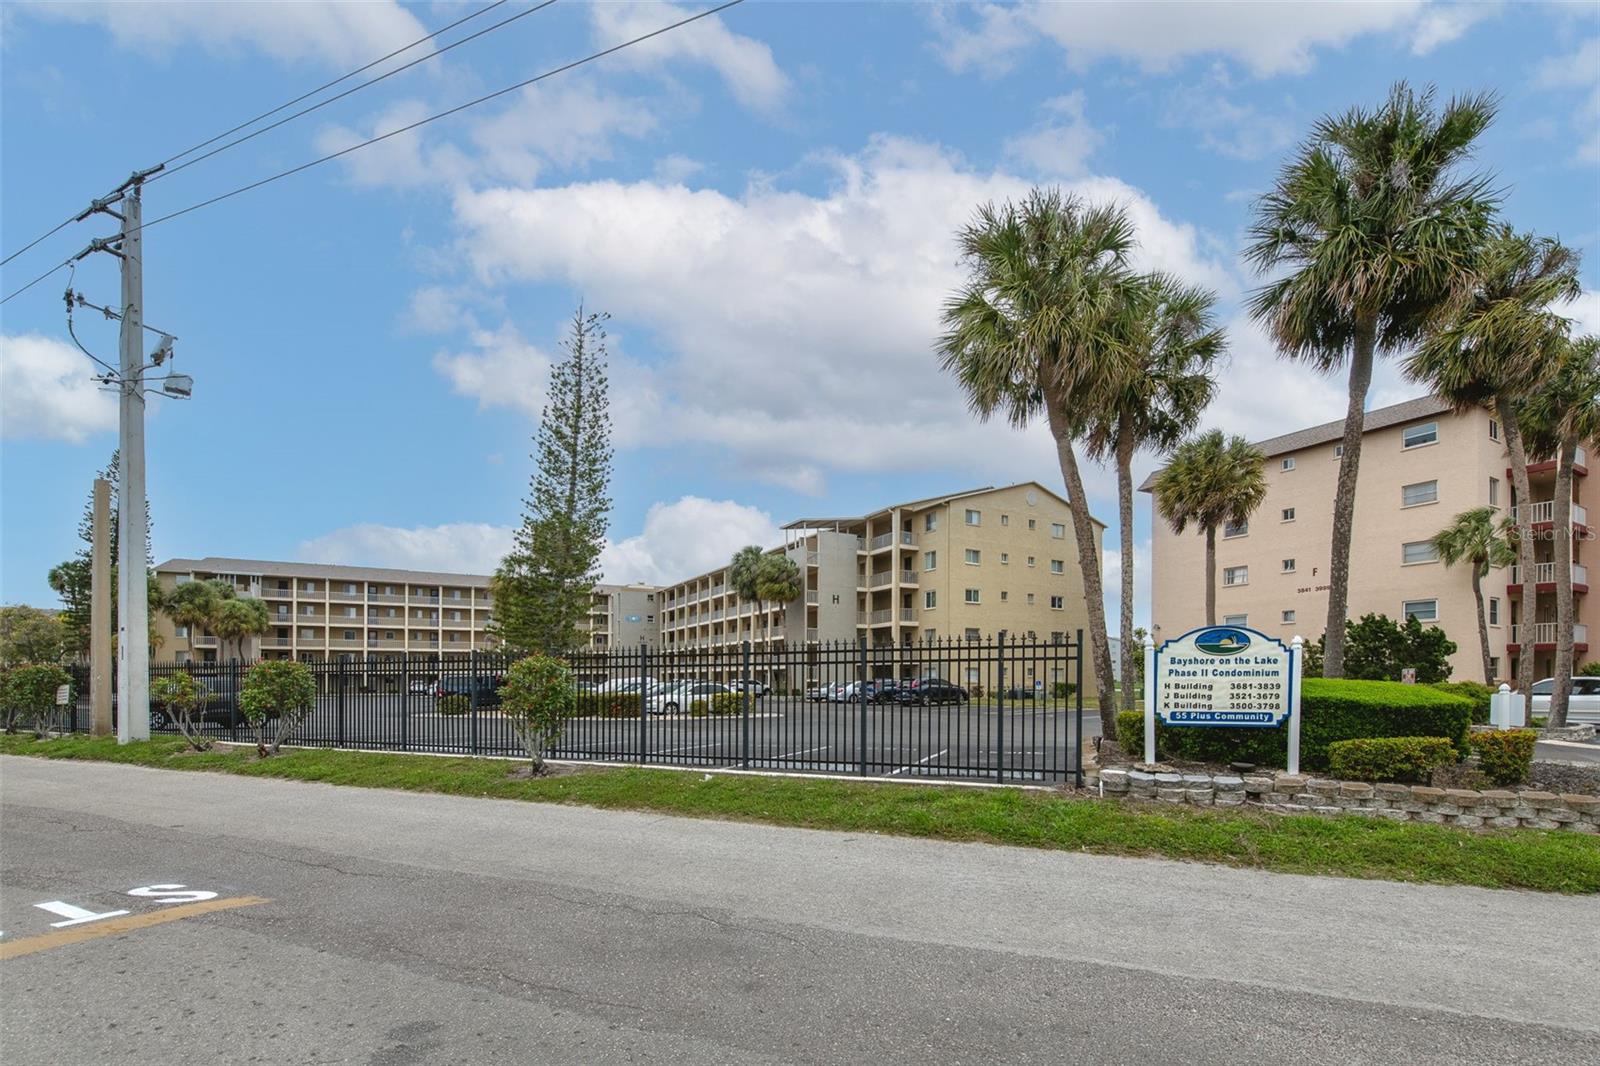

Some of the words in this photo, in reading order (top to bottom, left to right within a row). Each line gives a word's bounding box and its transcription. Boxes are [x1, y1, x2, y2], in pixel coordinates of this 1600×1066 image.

[1312, 568, 1318, 576] F
[832, 594, 840, 604] H
[1170, 656, 1215, 666] Bayshore
[1234, 657, 1250, 665] the
[1254, 656, 1278, 665] Lake
[1168, 669, 1198, 677] Phase
[1212, 669, 1280, 677] Condominium
[1174, 683, 1214, 691] Building
[1174, 692, 1212, 701] Building
[1174, 702, 1213, 711] Building
[1214, 713, 1270, 722] Community
